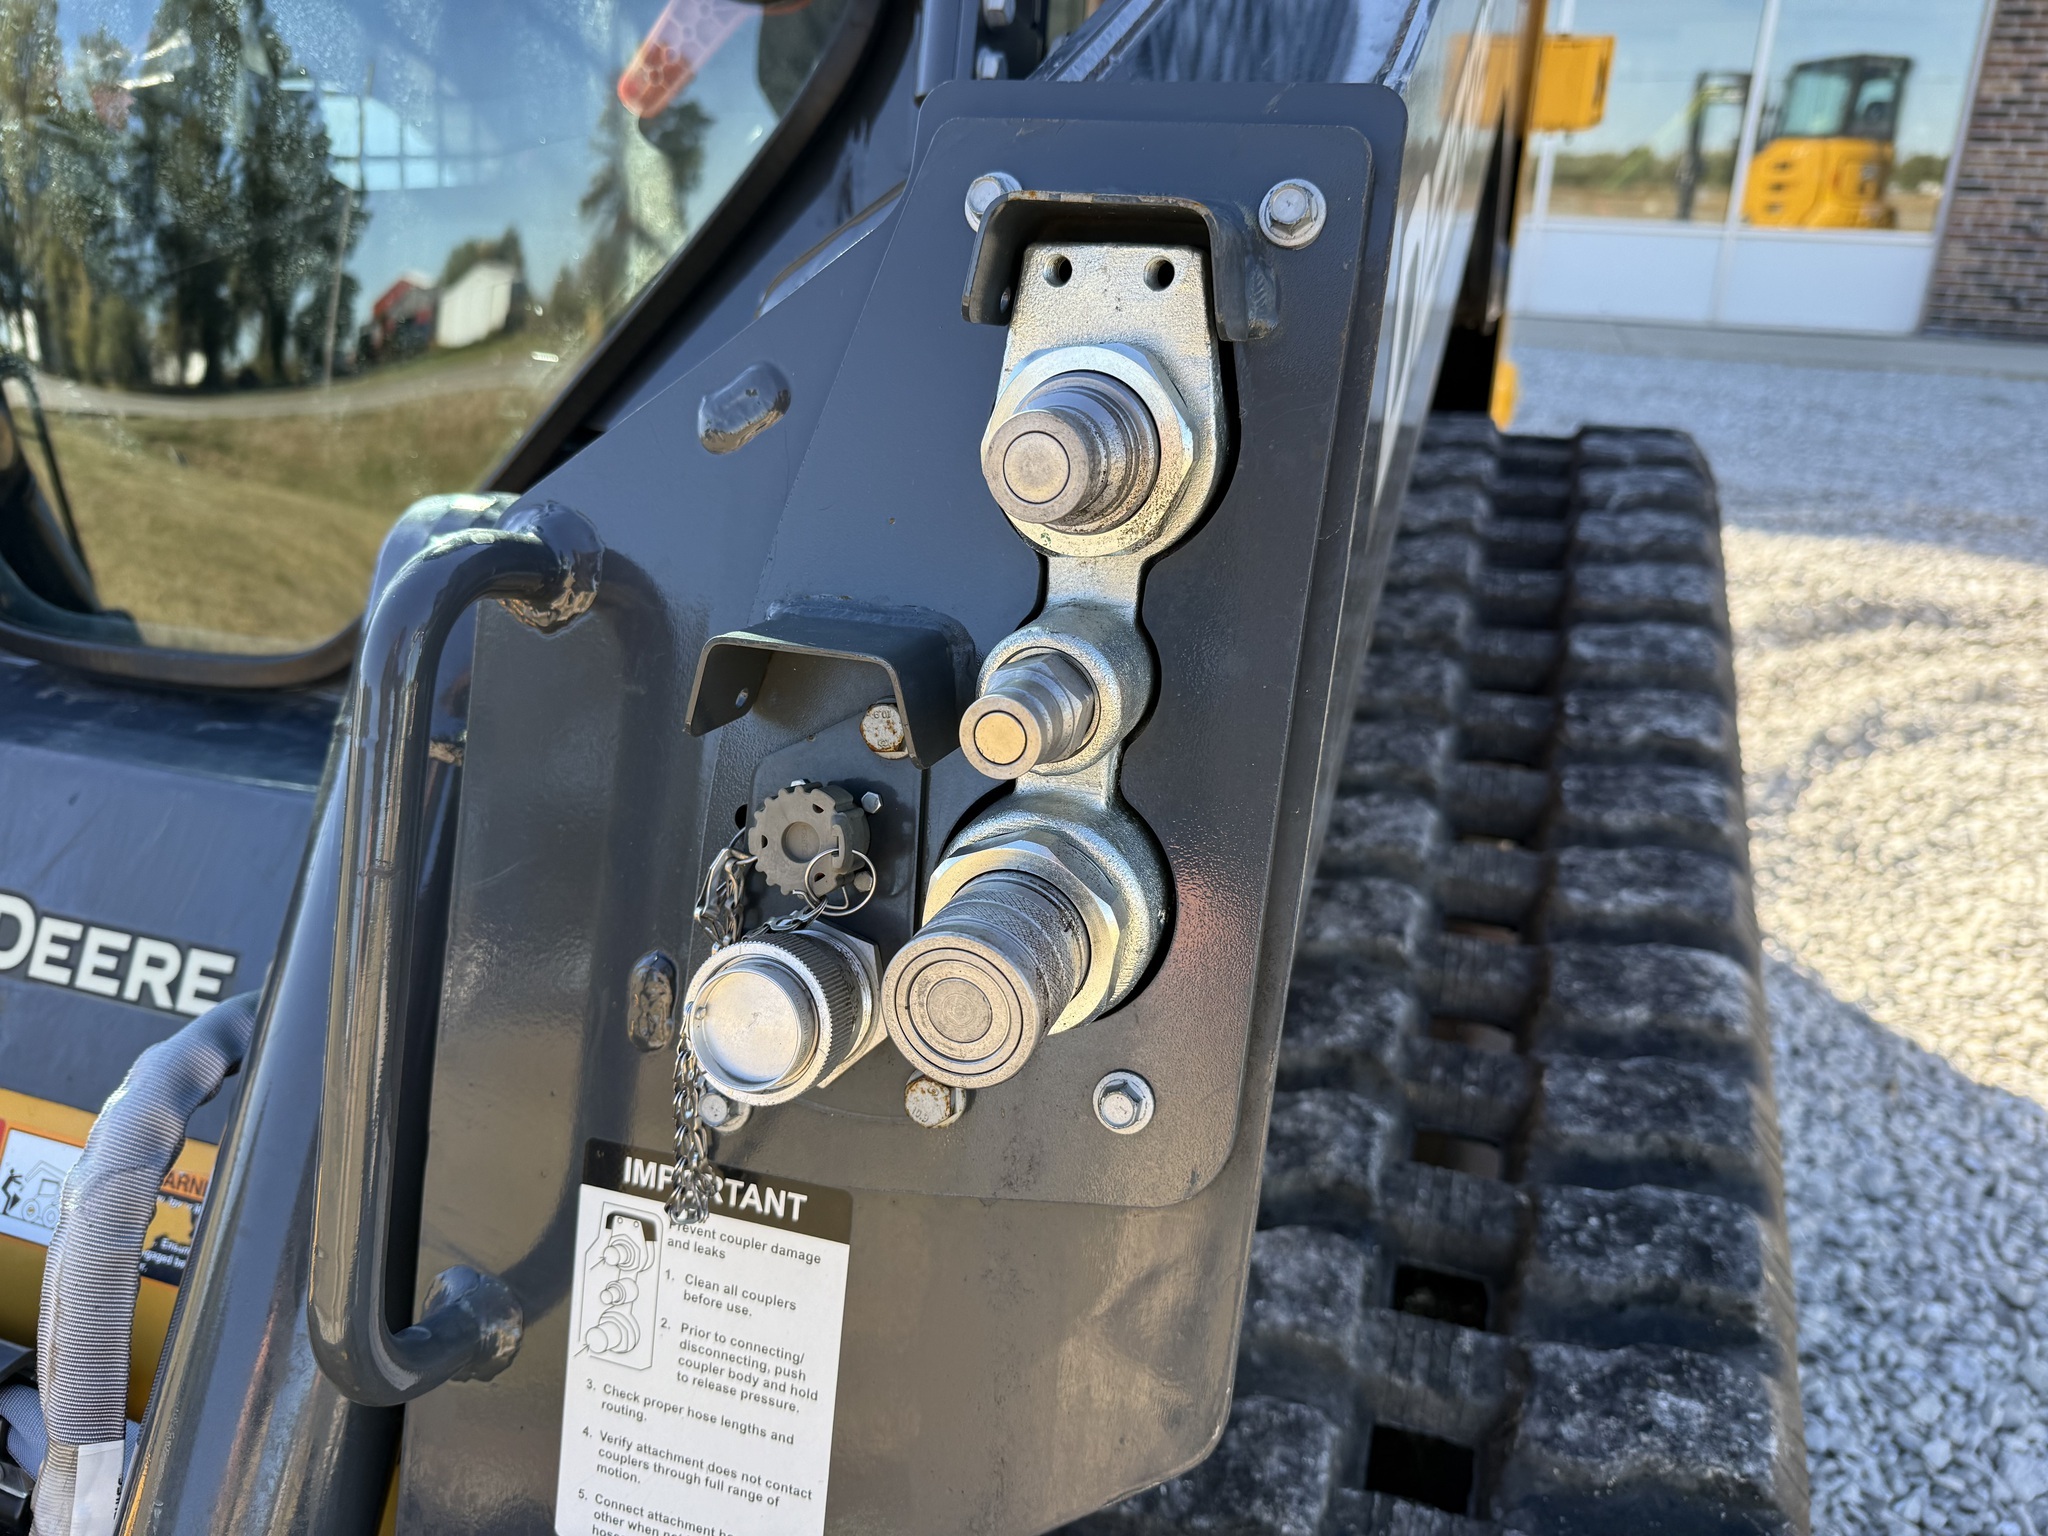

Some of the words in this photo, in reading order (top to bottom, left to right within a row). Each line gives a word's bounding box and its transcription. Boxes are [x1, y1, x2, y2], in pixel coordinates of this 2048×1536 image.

[0, 893, 235, 1016] DEERE
[623, 1156, 808, 1222] IMPRTANT
[668, 1238, 690, 1250] and
[694, 1242, 725, 1259] leaks
[720, 1234, 767, 1251] coupler
[771, 1243, 821, 1265] damage
[666, 1269, 674, 1280] 1.
[685, 1274, 719, 1291] Clean
[724, 1285, 737, 1296] all
[742, 1290, 796, 1310] couplers
[684, 1290, 722, 1308] before
[727, 1303, 751, 1316] use.
[661, 1318, 670, 1329] 2.
[681, 1323, 711, 1339] Prior
[715, 1332, 726, 1343] to
[730, 1338, 804, 1365] connecting/
[680, 1340, 770, 1374] disconnecting,
[775, 1366, 805, 1381] push
[677, 1371, 688, 1382] to
[693, 1377, 736, 1395] release
[741, 1390, 799, 1413] pressure.
[678, 1358, 725, 1376] coupler
[728, 1367, 759, 1387] body
[763, 1380, 786, 1393] and
[790, 1384, 818, 1401] hold
[587, 1379, 595, 1390] 3.
[604, 1384, 639, 1403] Check
[644, 1397, 684, 1414] proper
[688, 1407, 717, 1423] hose
[721, 1416, 766, 1437] lengths
[771, 1432, 794, 1445] and
[602, 1402, 646, 1422] routing.
[583, 1426, 592, 1437] 4.
[600, 1431, 632, 1451] Verify
[637, 1444, 703, 1469] attachment
[708, 1462, 737, 1478] does
[742, 1473, 761, 1486] not
[766, 1480, 811, 1500] contact
[597, 1464, 640, 1483] motion.
[599, 1449, 649, 1470] couplers
[654, 1462, 700, 1484] through
[705, 1476, 723, 1491] full
[728, 1486, 762, 1502] range
[767, 1496, 779, 1507] of
[579, 1489, 587, 1500] 5.
[595, 1494, 643, 1517] Connect
[648, 1511, 715, 1536] attachment
[594, 1511, 624, 1526] other
[628, 1521, 659, 1536] when
